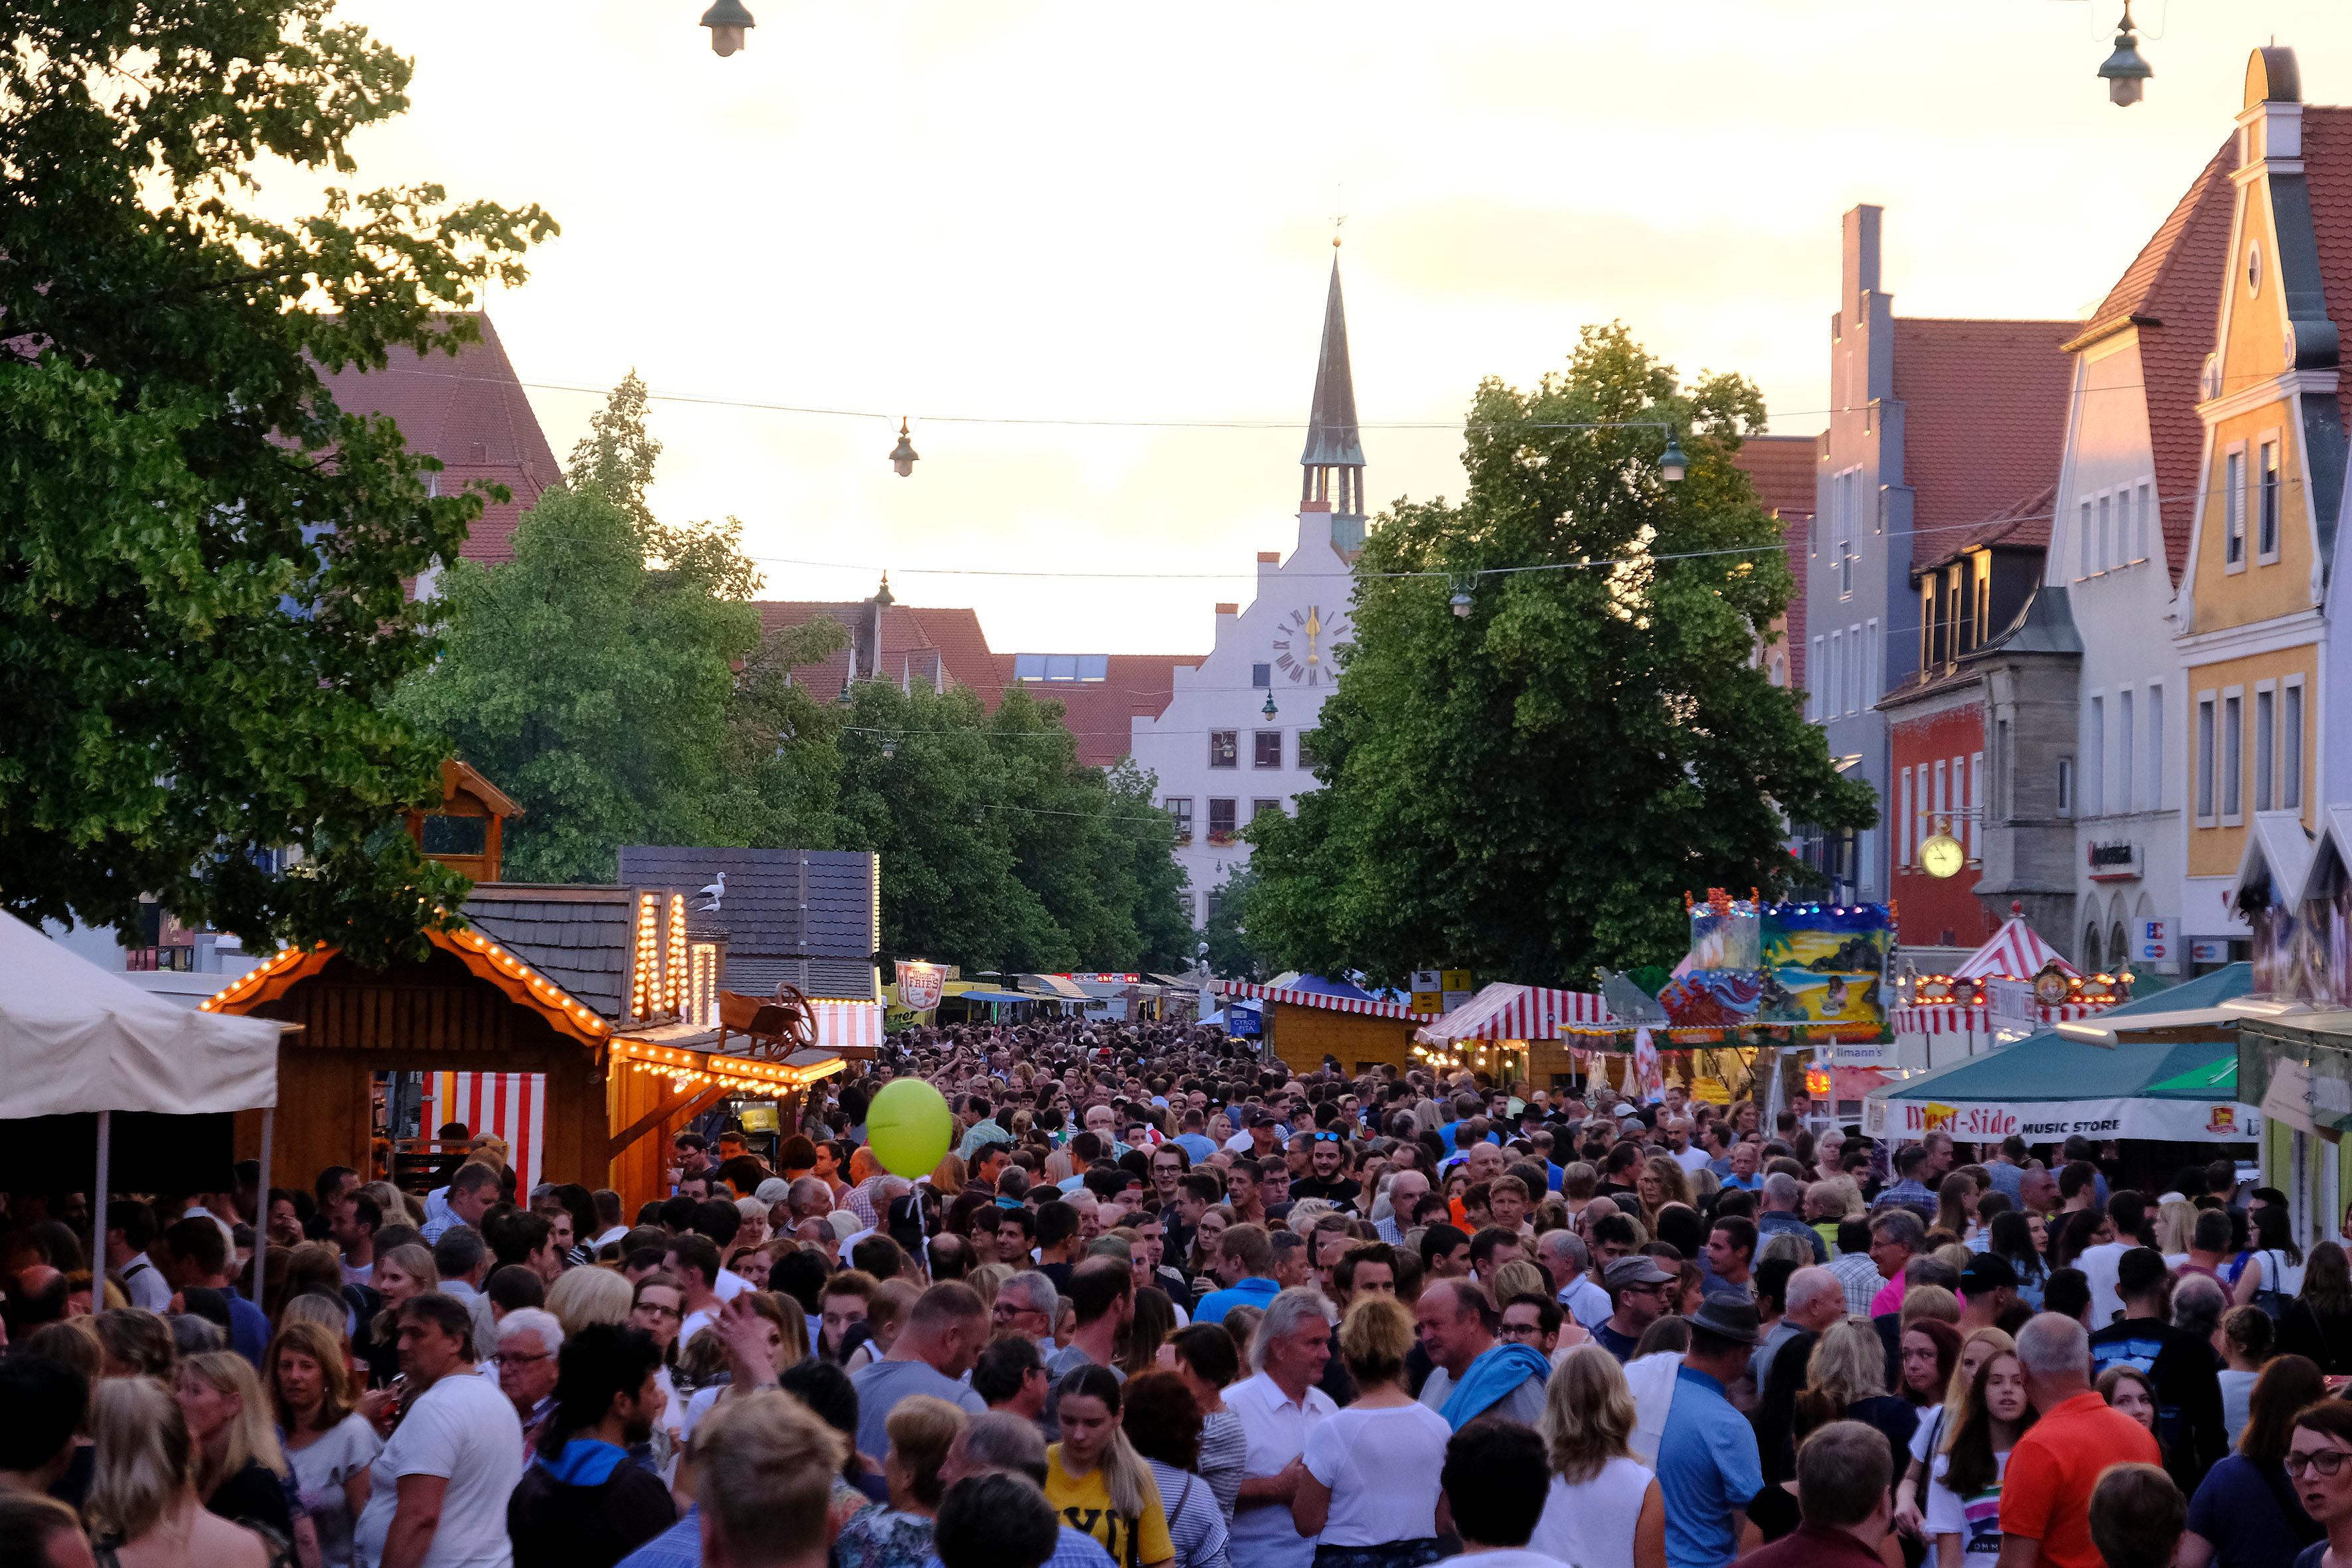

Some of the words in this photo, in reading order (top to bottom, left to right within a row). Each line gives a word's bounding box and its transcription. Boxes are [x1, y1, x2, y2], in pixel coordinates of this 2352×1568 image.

[913, 971, 936, 980] Western
[909, 977, 939, 989] FRIES
[1905, 1105, 2017, 1136] West-Side
[2022, 1122, 2069, 1135] MUSIC
[2073, 1119, 2120, 1133] STORE
